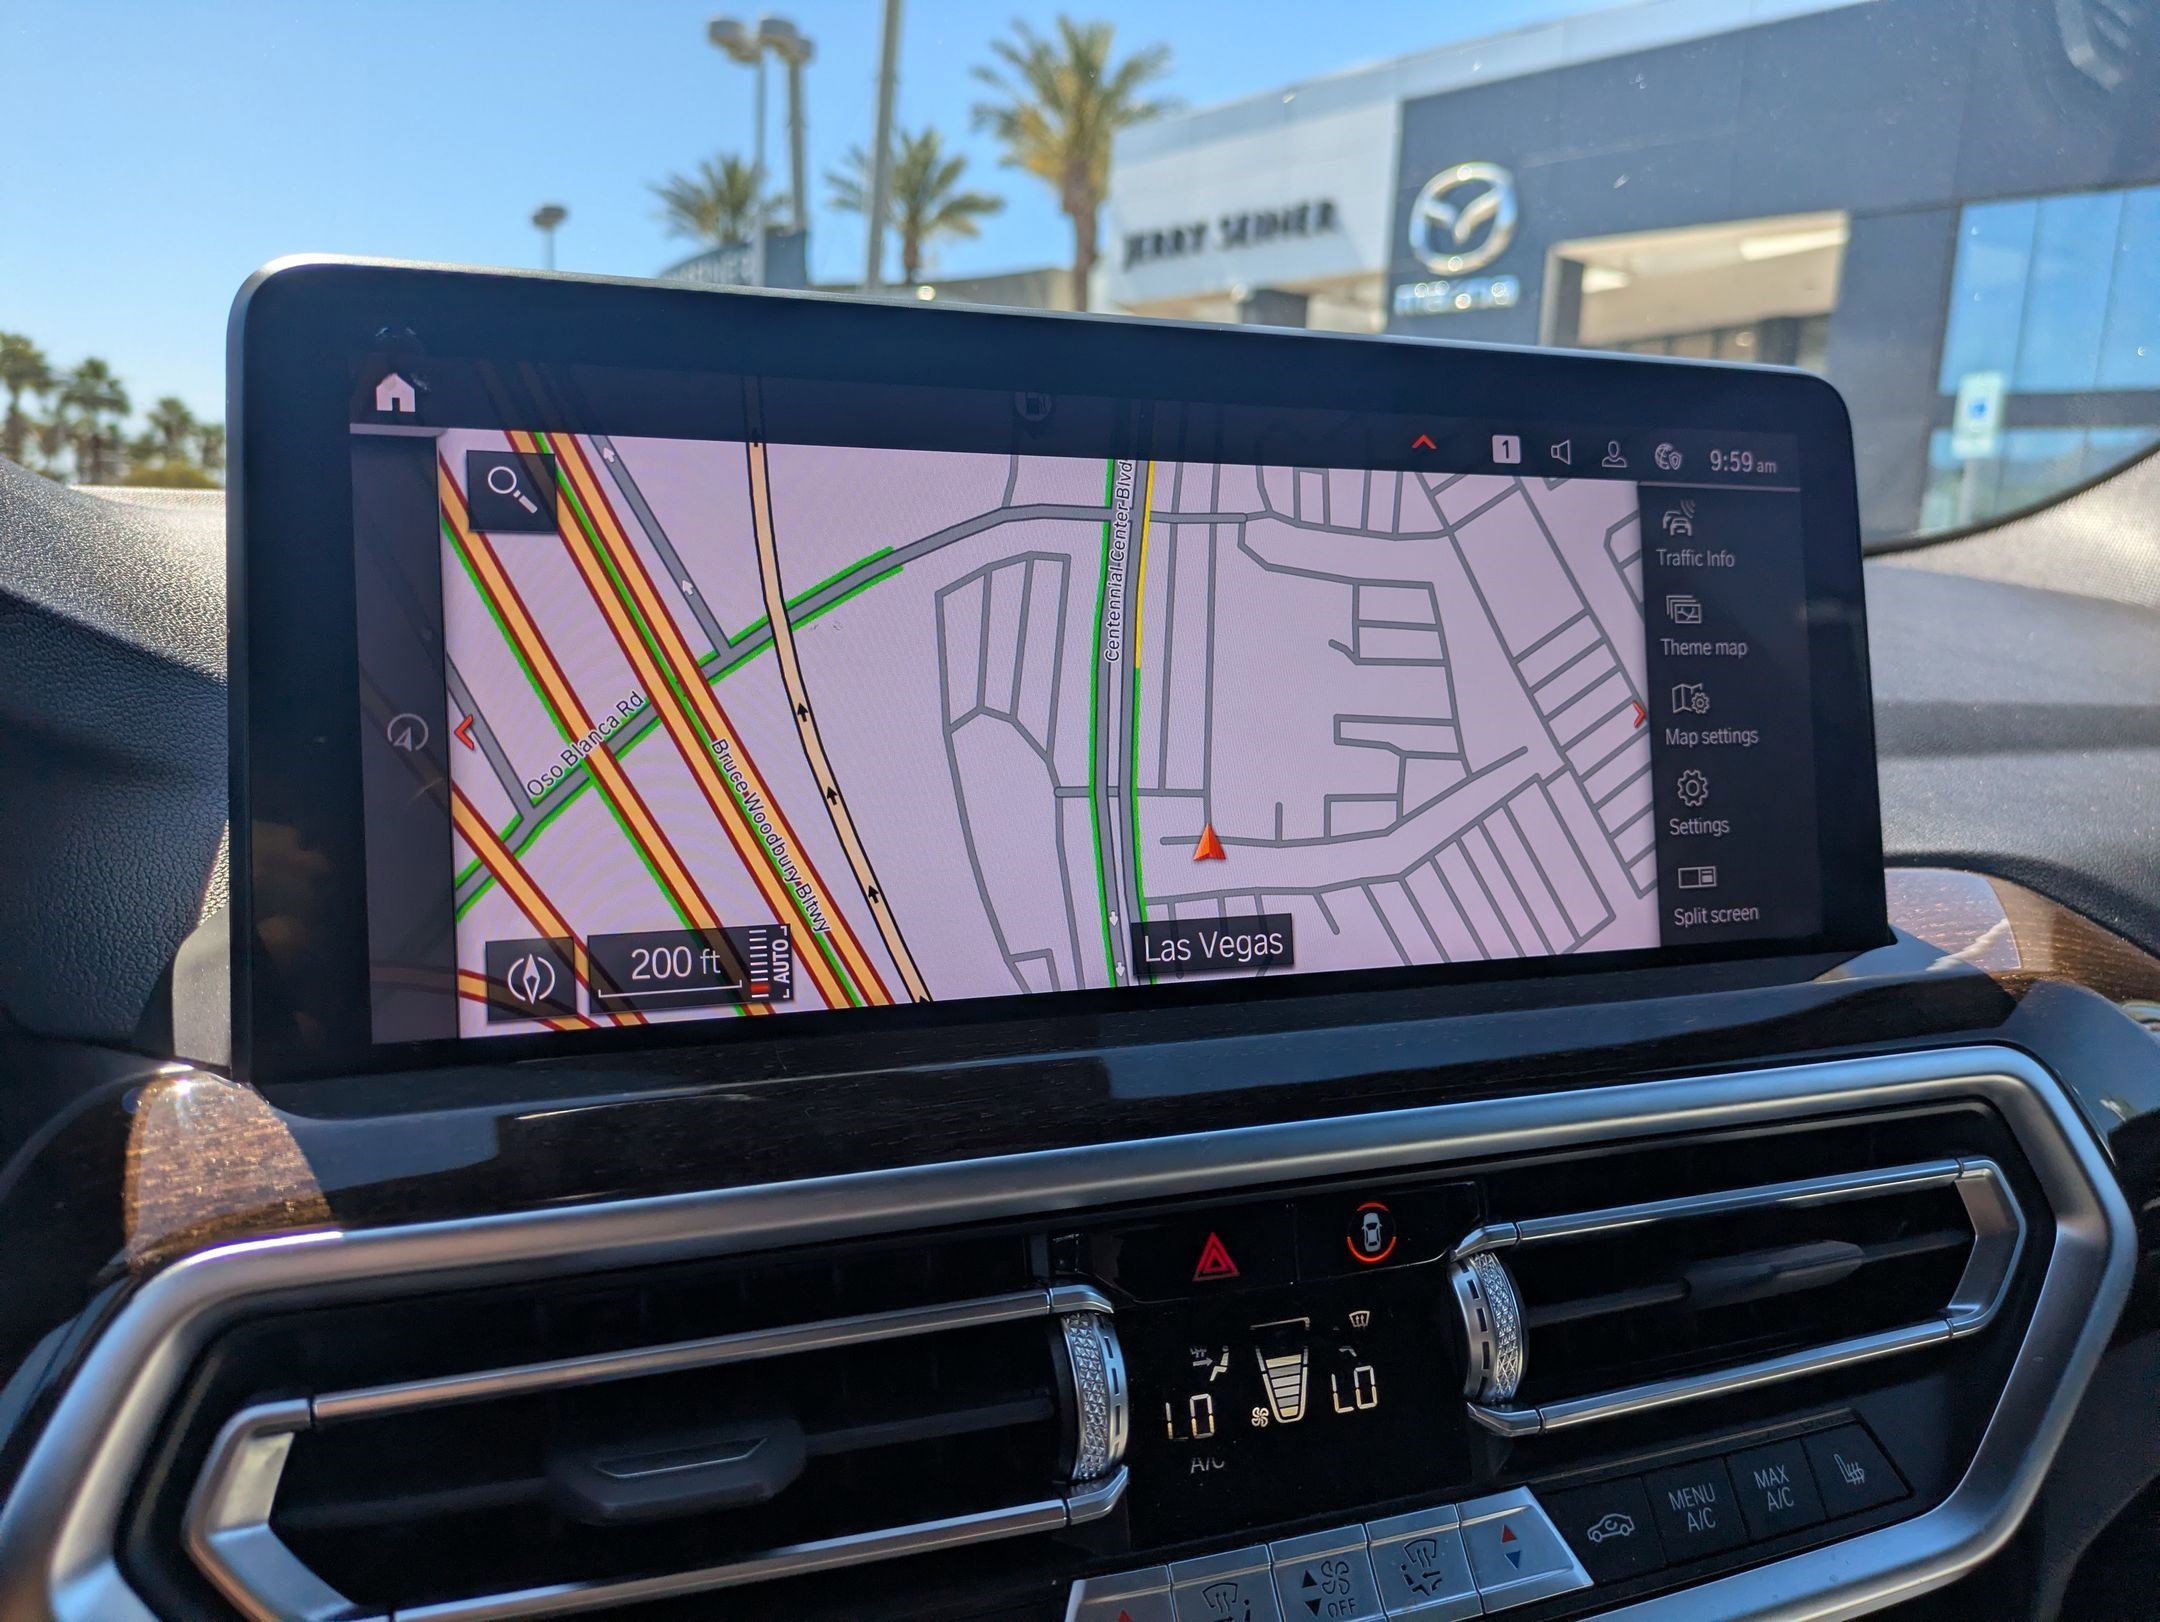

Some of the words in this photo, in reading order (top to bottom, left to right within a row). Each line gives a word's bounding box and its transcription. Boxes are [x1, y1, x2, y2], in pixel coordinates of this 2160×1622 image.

[1710, 449, 1753, 473] 9:59
[1756, 462, 1777, 473] am
[1116, 459, 1133, 500] Blvd
[1111, 504, 1130, 563] Center
[1656, 547, 1703, 567] Traffic
[1706, 549, 1735, 567] Info
[1105, 566, 1125, 662] Centennial
[1660, 638, 1712, 656] Theme
[1715, 641, 1748, 659] map
[527, 765, 563, 796] Oso
[560, 715, 620, 767] Blanca
[615, 691, 644, 718] Rd
[1665, 728, 1698, 748] Map
[1701, 728, 1759, 747] settings
[712, 738, 748, 793] Bruce
[744, 792, 801, 883] Woodbury
[795, 882, 830, 932] Bltwy
[1669, 818, 1730, 838] Settings
[1674, 907, 1708, 928] Split
[1711, 906, 1759, 923] screen
[1144, 935, 1192, 963] Las
[1199, 930, 1284, 963] Vegas
[631, 945, 692, 980] 200
[700, 948, 721, 975] ft
[772, 939, 790, 984] AUTO
[1753, 1464, 1790, 1489] MAX
[1667, 1482, 1716, 1511] MENU
[1767, 1486, 1795, 1512] A/C
[1687, 1507, 1716, 1533] A/C
[1327, 1598, 1357, 1618] OFF
